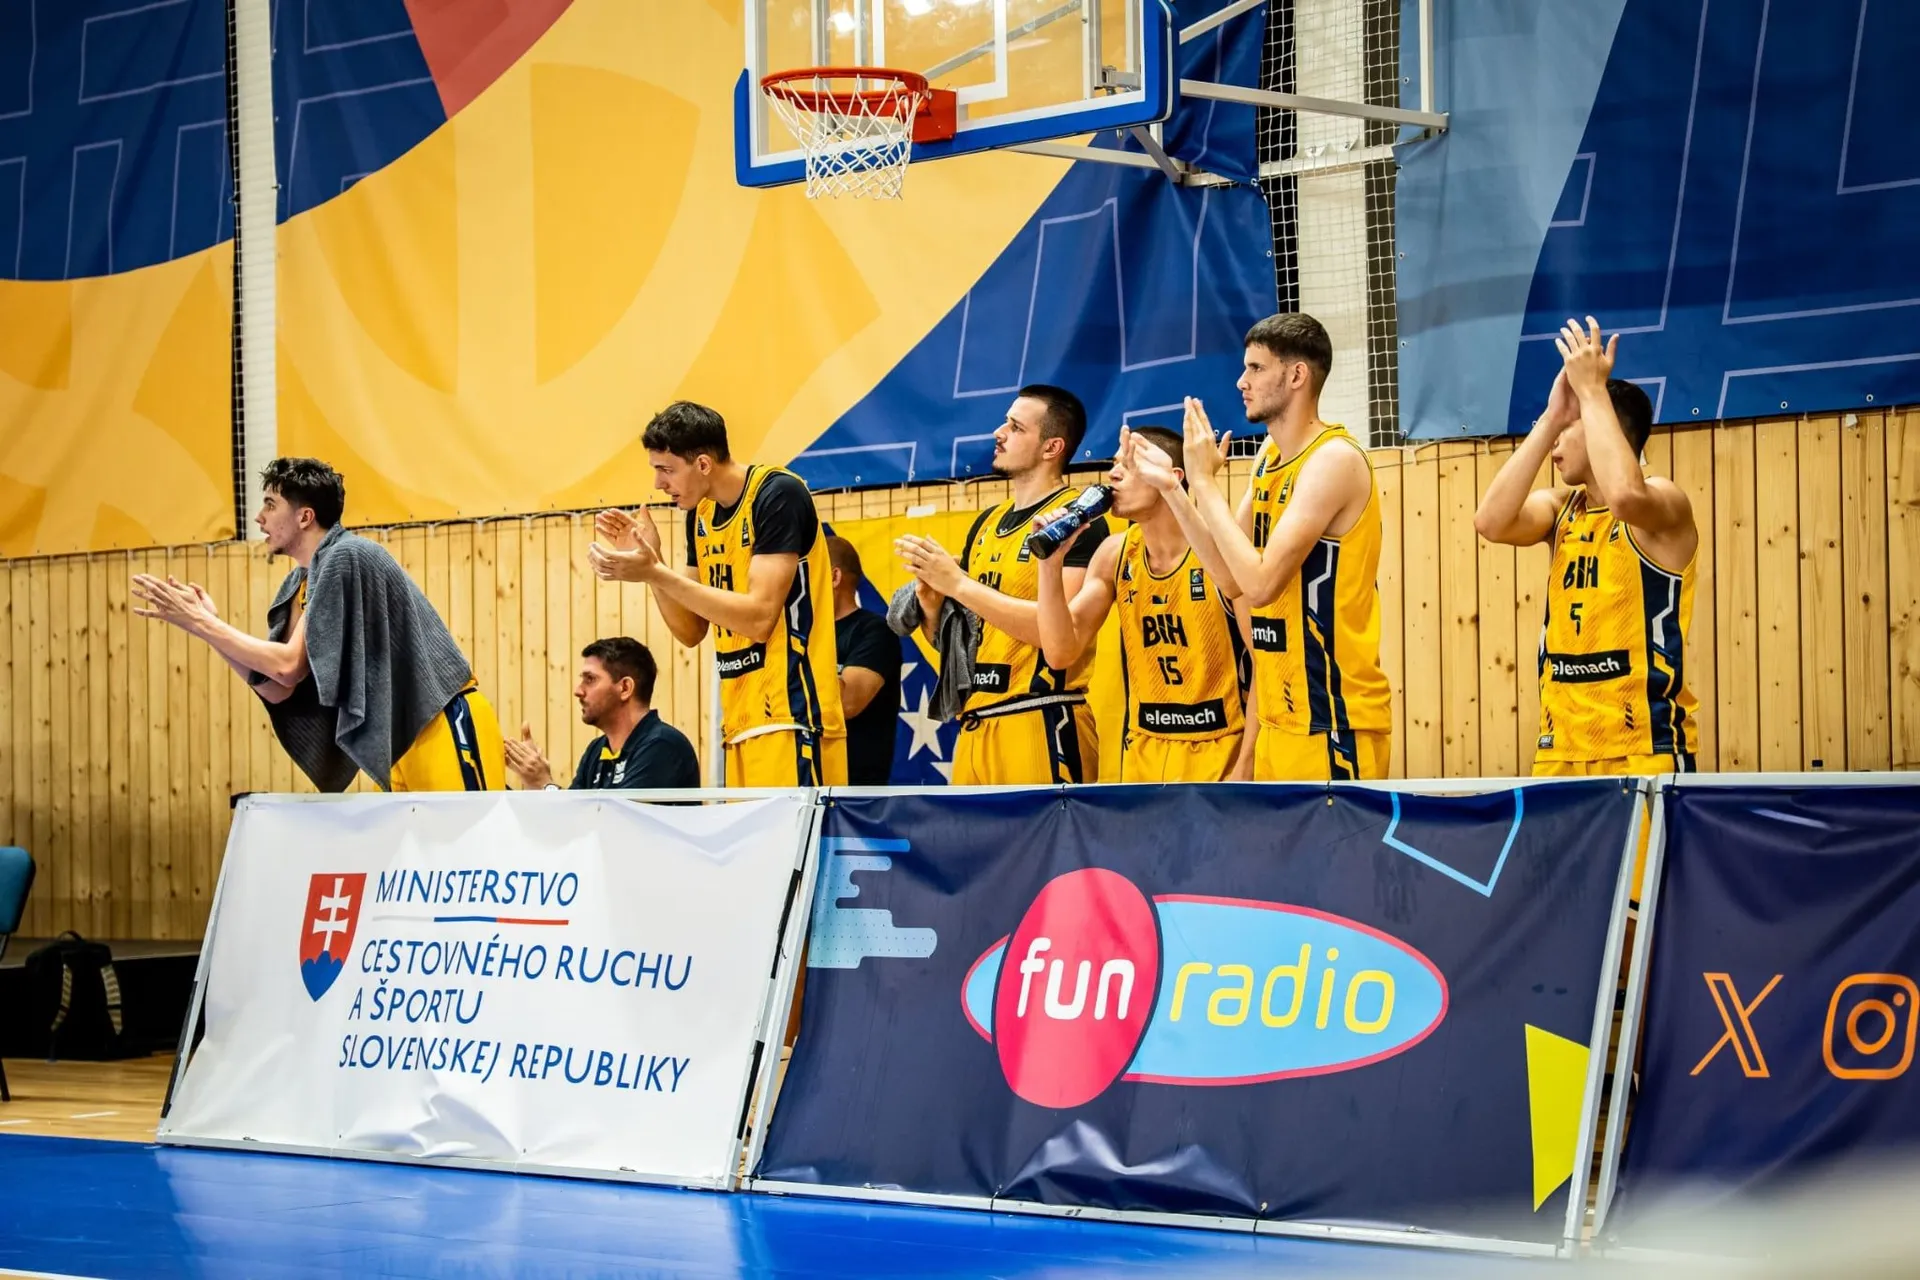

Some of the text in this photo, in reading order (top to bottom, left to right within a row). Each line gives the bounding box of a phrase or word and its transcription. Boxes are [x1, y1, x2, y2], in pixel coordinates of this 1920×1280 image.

[1142, 613, 1188, 648] BIH
[1157, 656, 1184, 686] 15
[1145, 708, 1217, 725] elemach
[375, 869, 578, 907] MINISTERSTVO
[361, 933, 693, 991] CESTOVNÉHO RUCHU
[348, 978, 483, 1025] A ŠPORTU
[1016, 937, 1396, 1034] fun radio
[339, 1034, 691, 1093] SLOVENSKEJ REPUBLIKY
